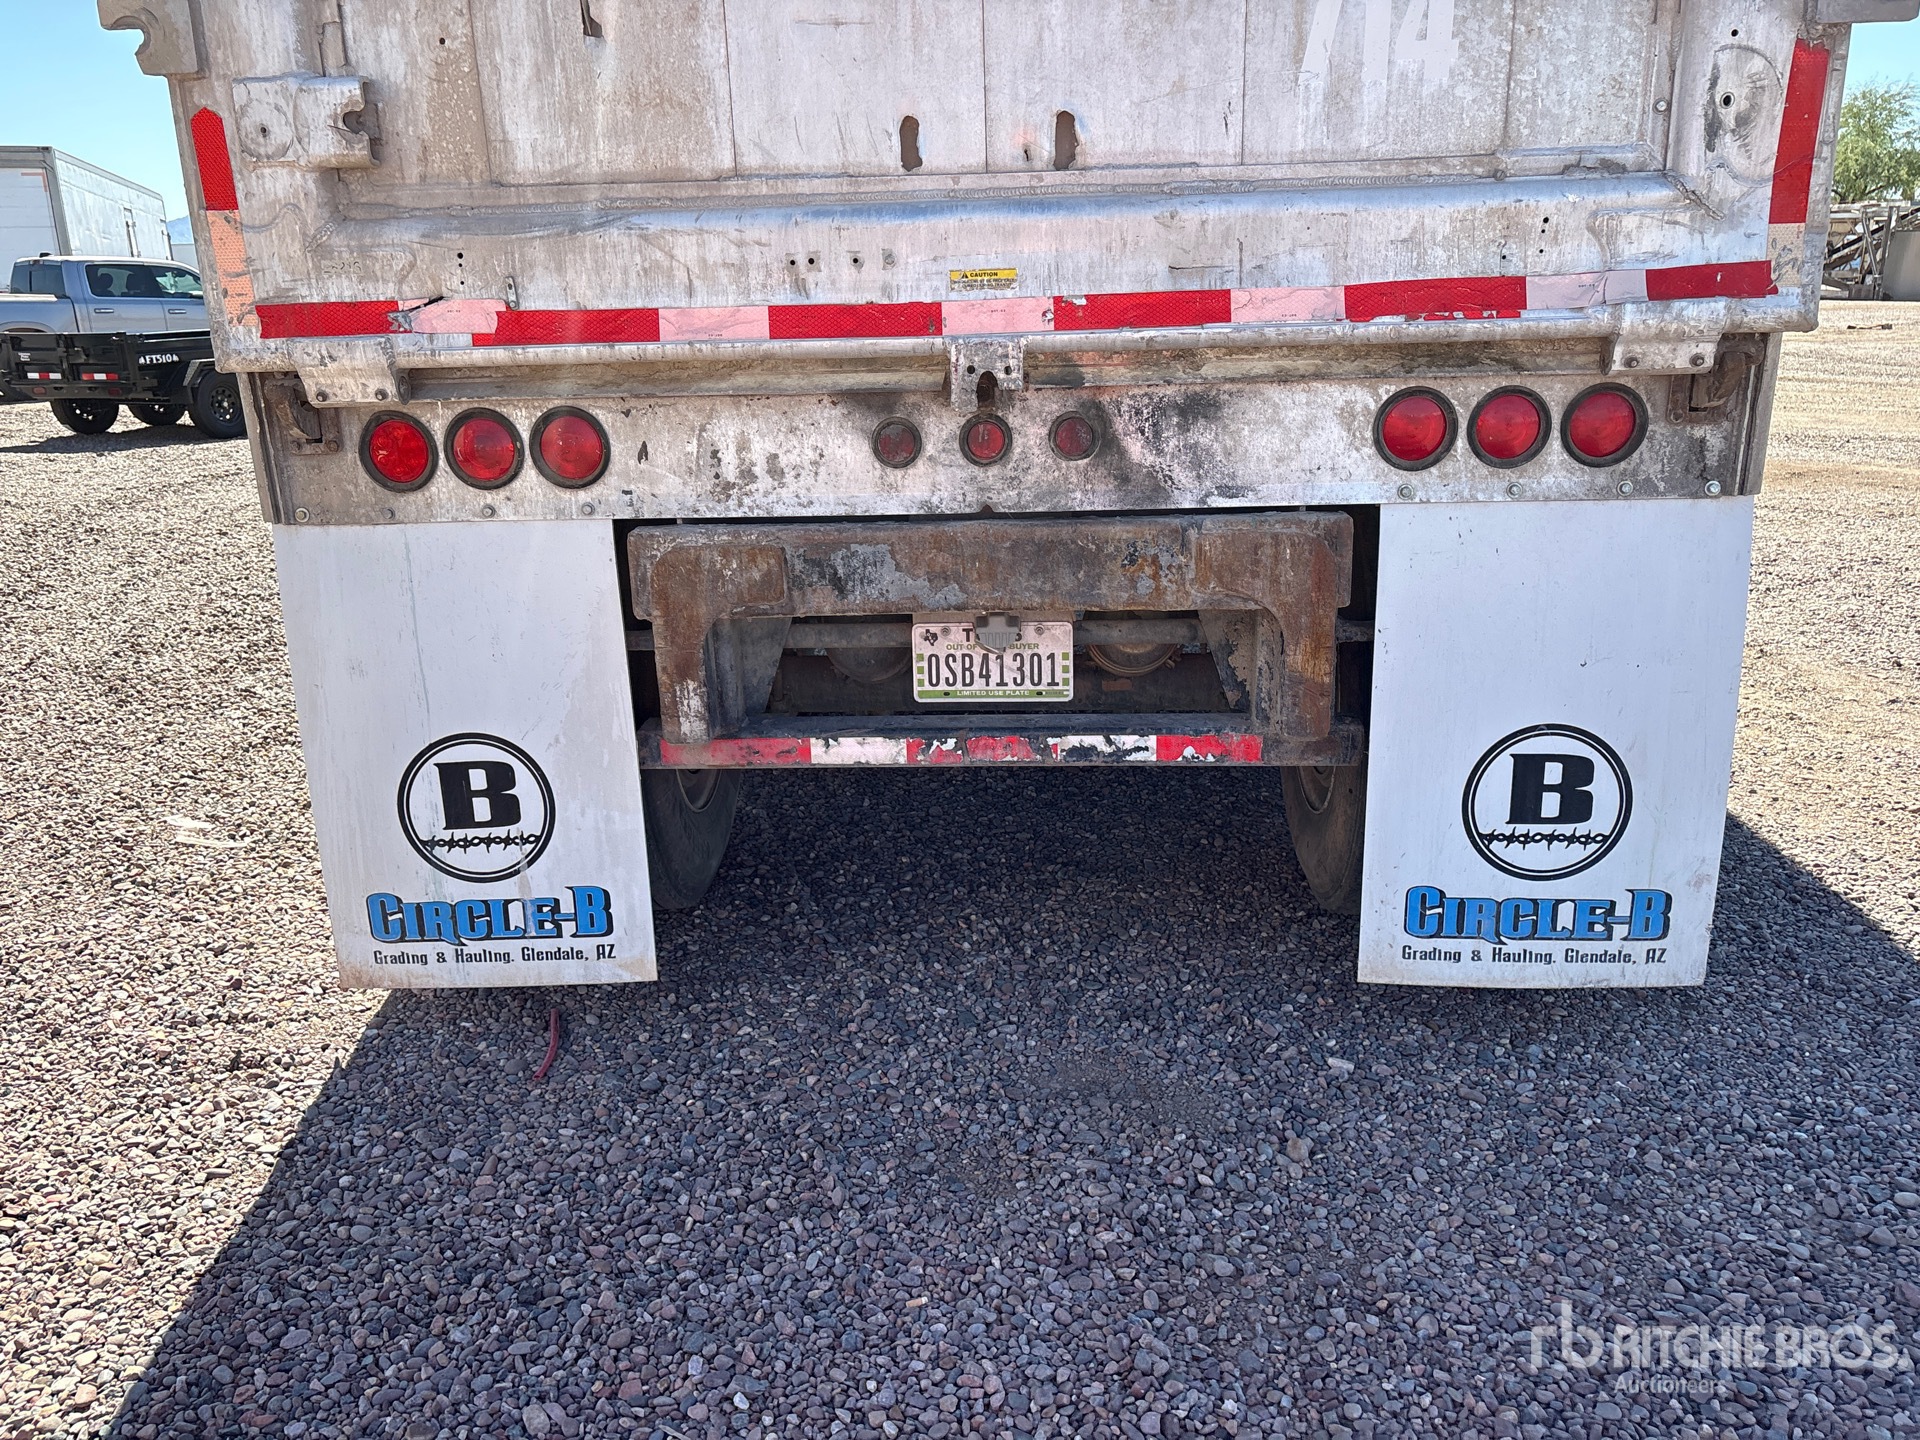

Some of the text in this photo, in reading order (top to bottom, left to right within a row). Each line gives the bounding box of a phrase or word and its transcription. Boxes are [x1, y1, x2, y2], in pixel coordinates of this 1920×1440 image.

[946, 643, 965, 651] OUT
[433, 760, 521, 830] B
[1505, 753, 1595, 825] B
[373, 950, 428, 965] Grading
[436, 951, 448, 963] &
[521, 947, 589, 962] Glendale,
[596, 944, 616, 961] AZ
[1402, 945, 1462, 964] Grading
[1470, 950, 1483, 962] &
[1564, 947, 1637, 965] Glendale,
[1645, 948, 1667, 964] AZ
